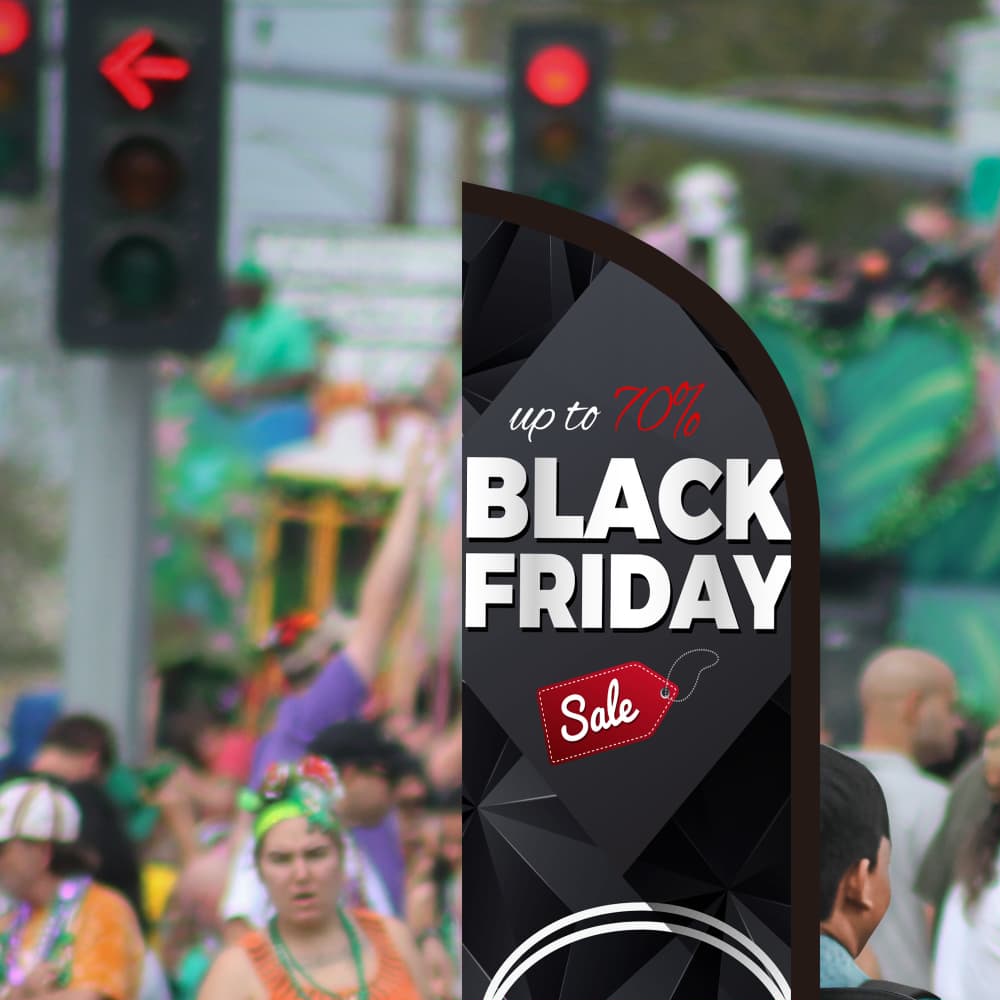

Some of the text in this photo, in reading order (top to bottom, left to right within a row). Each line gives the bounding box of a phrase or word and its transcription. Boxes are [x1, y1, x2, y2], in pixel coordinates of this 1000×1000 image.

[509, 381, 706, 443] up to 70%
[466, 456, 792, 543] BLACK
[464, 552, 792, 633] FRIDAY
[560, 678, 640, 742] Sale
